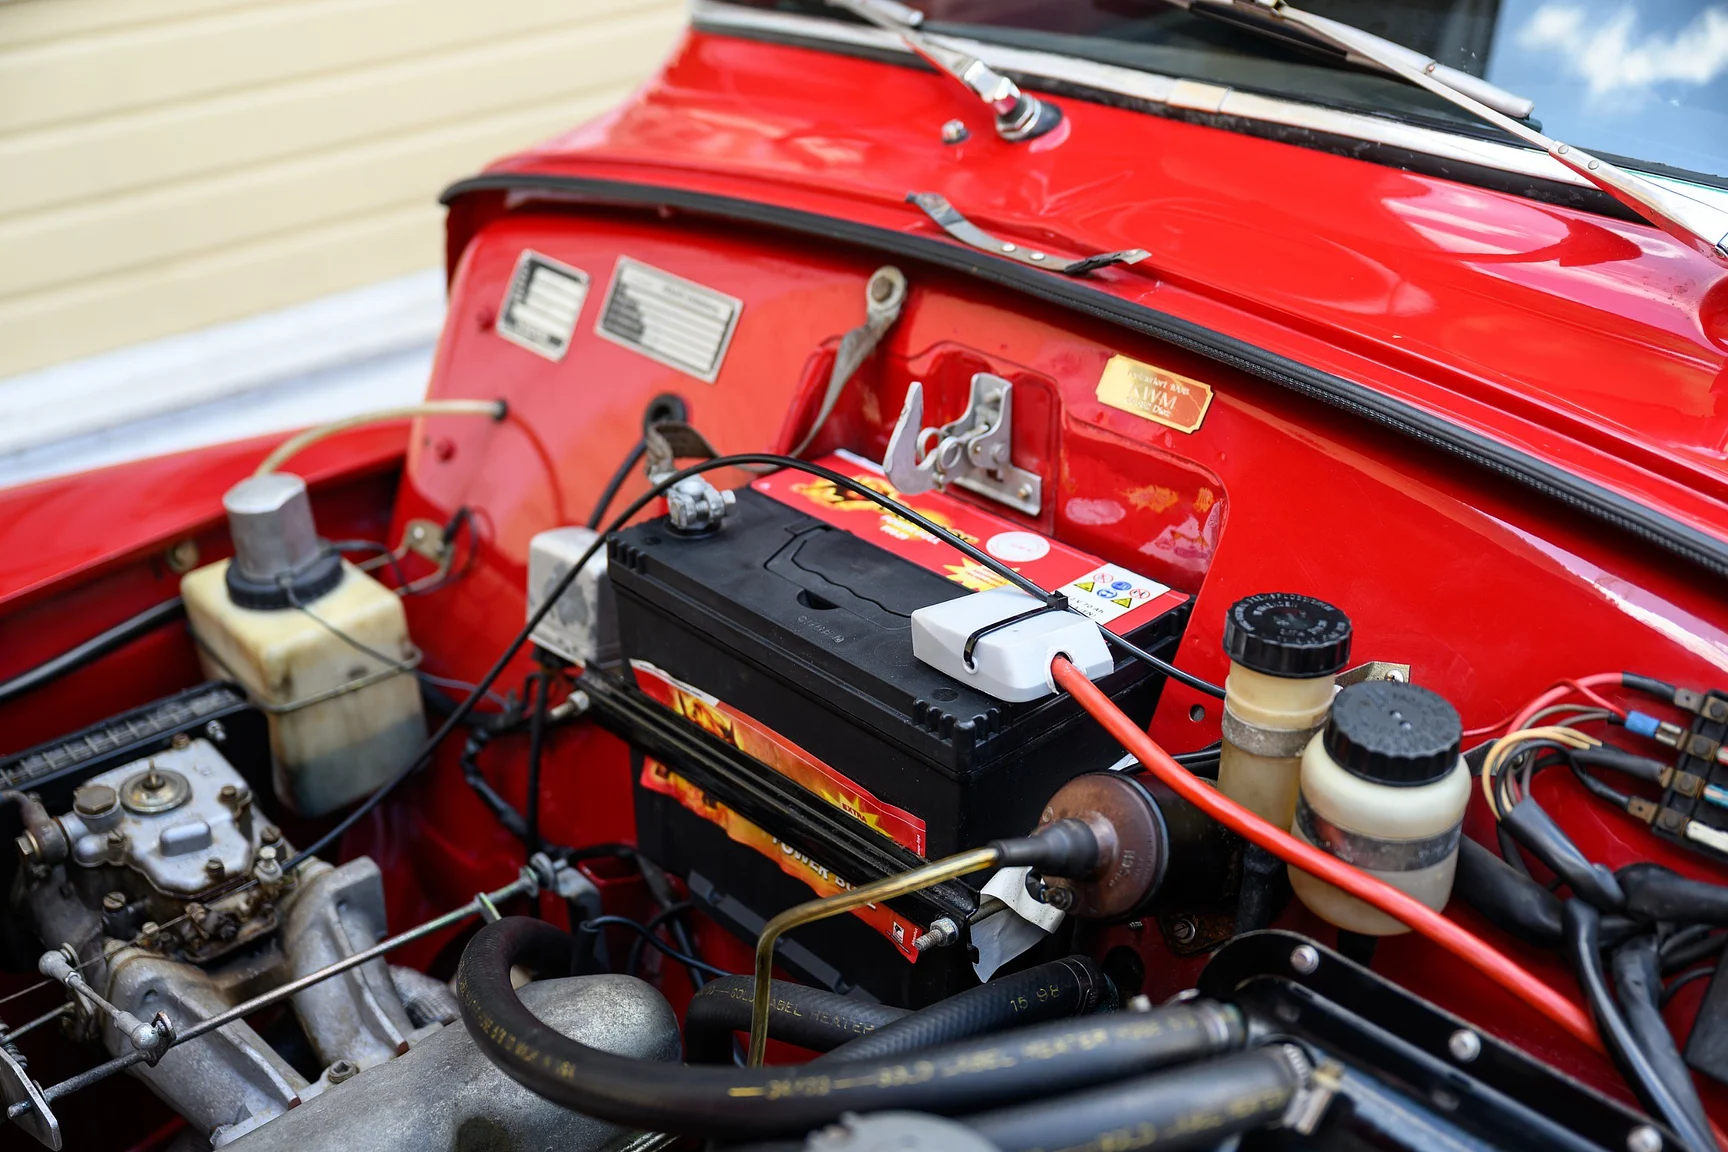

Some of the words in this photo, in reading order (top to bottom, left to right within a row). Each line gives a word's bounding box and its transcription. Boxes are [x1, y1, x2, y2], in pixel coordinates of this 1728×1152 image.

[842, 803, 868, 823] EXTRA
[772, 836, 829, 880] OWER
[768, 998, 802, 1017] ABEL
[1010, 997, 1028, 1012] 15
